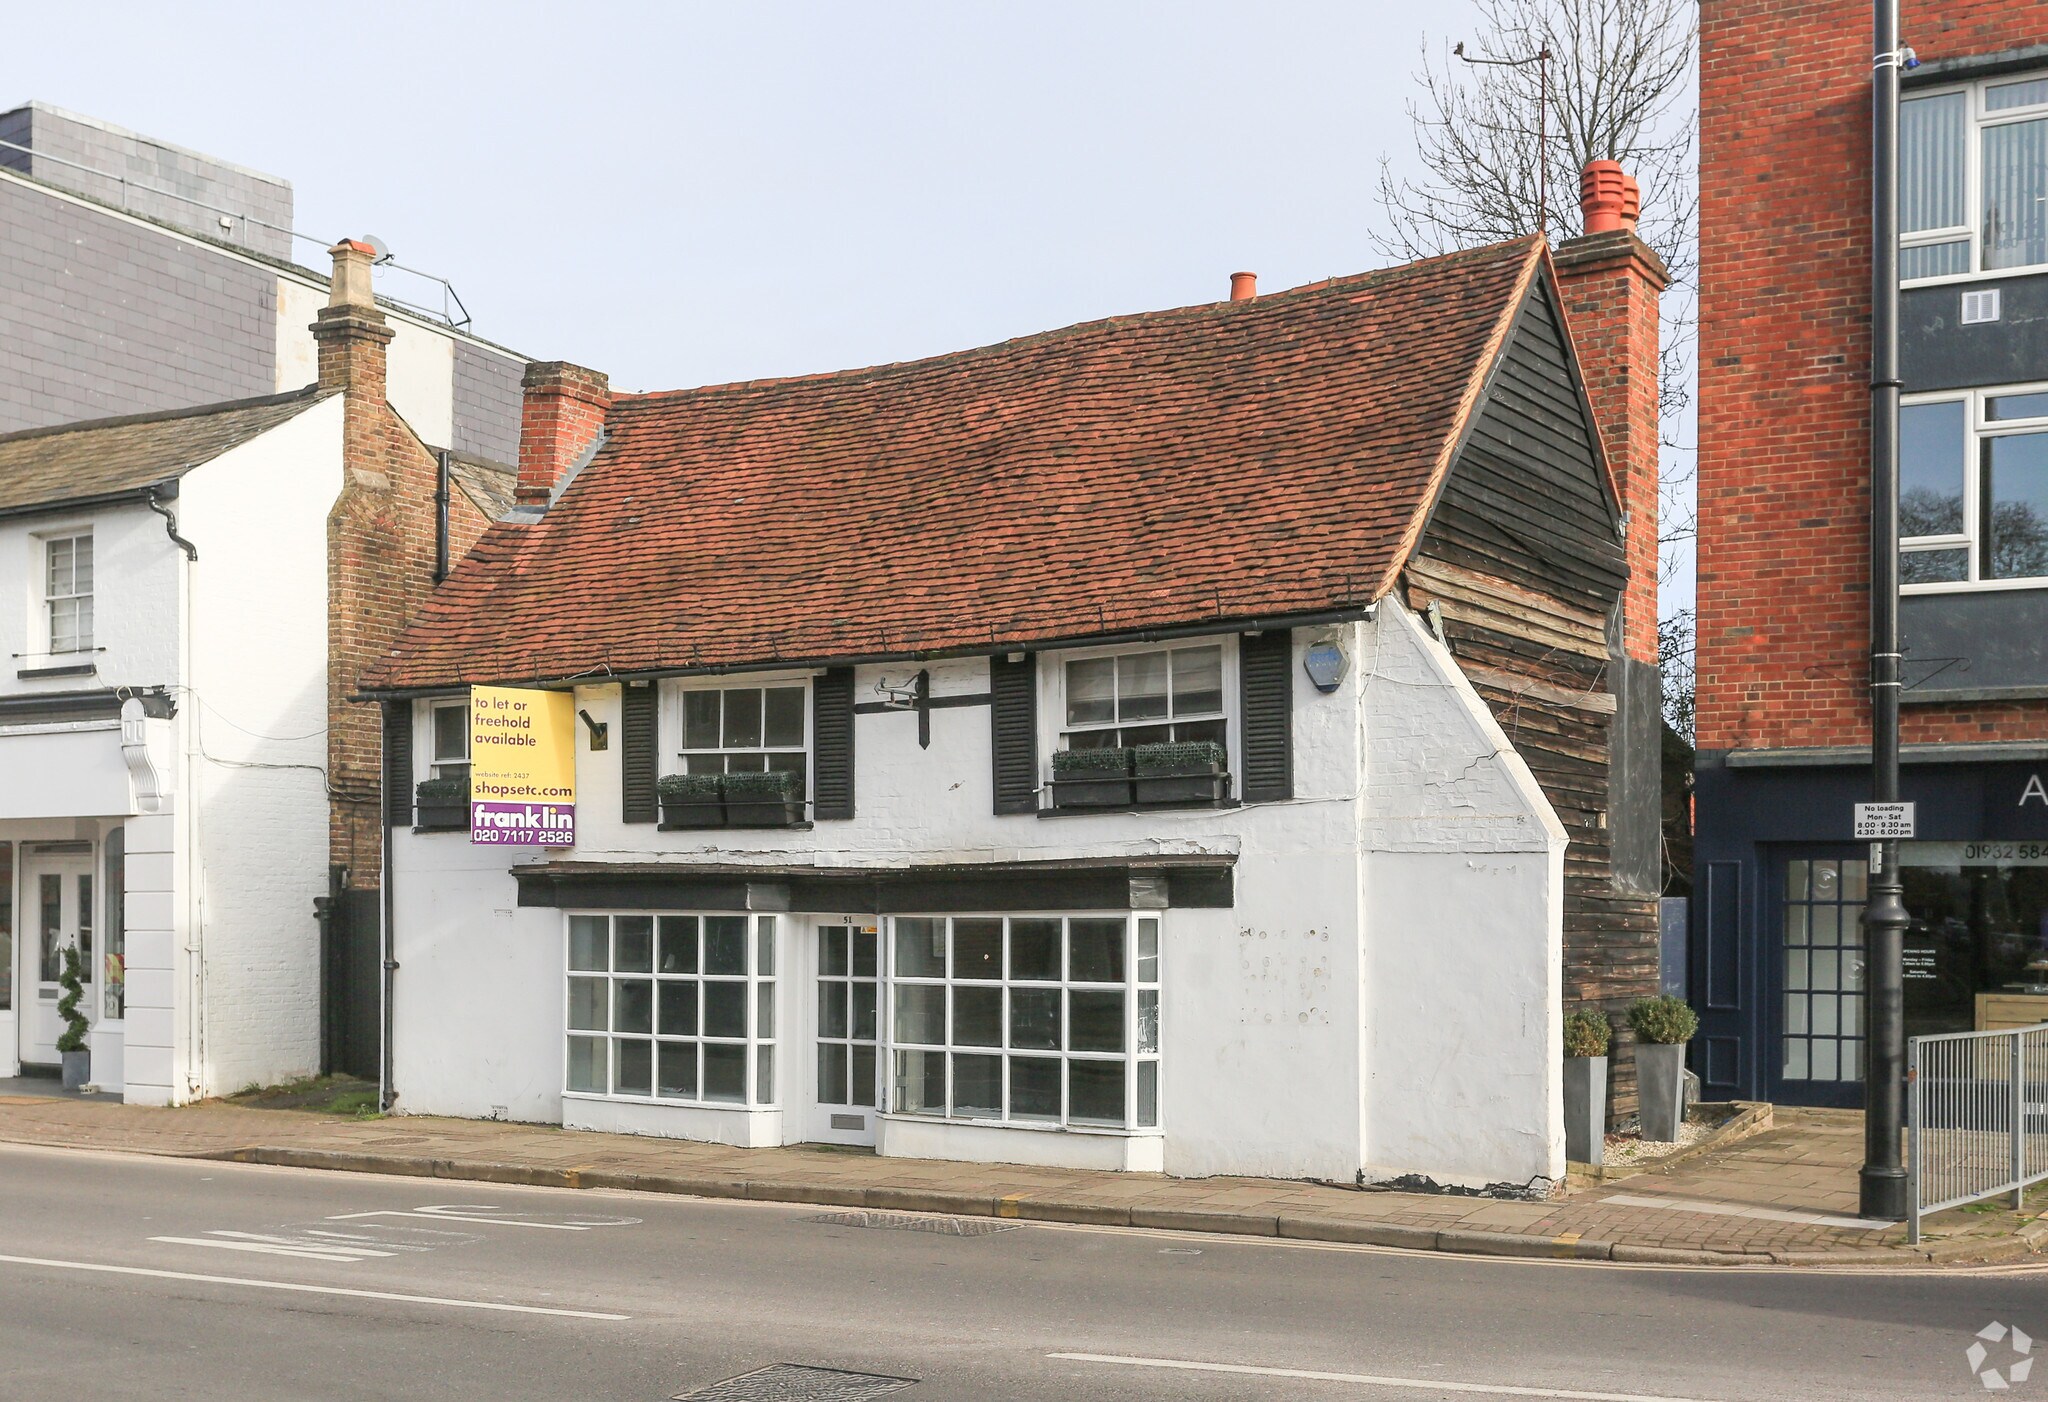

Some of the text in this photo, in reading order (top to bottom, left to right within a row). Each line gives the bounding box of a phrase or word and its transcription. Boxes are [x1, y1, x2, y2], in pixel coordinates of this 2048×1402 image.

[475, 696, 527, 711] to let or
[475, 713, 531, 729] freehold
[475, 732, 537, 747] available
[475, 781, 573, 798] shopsetc.com
[474, 804, 573, 829] franklin
[474, 829, 573, 843] 020 7117 2526
[1965, 845, 2013, 859] 01932
[843, 916, 853, 924] 51
